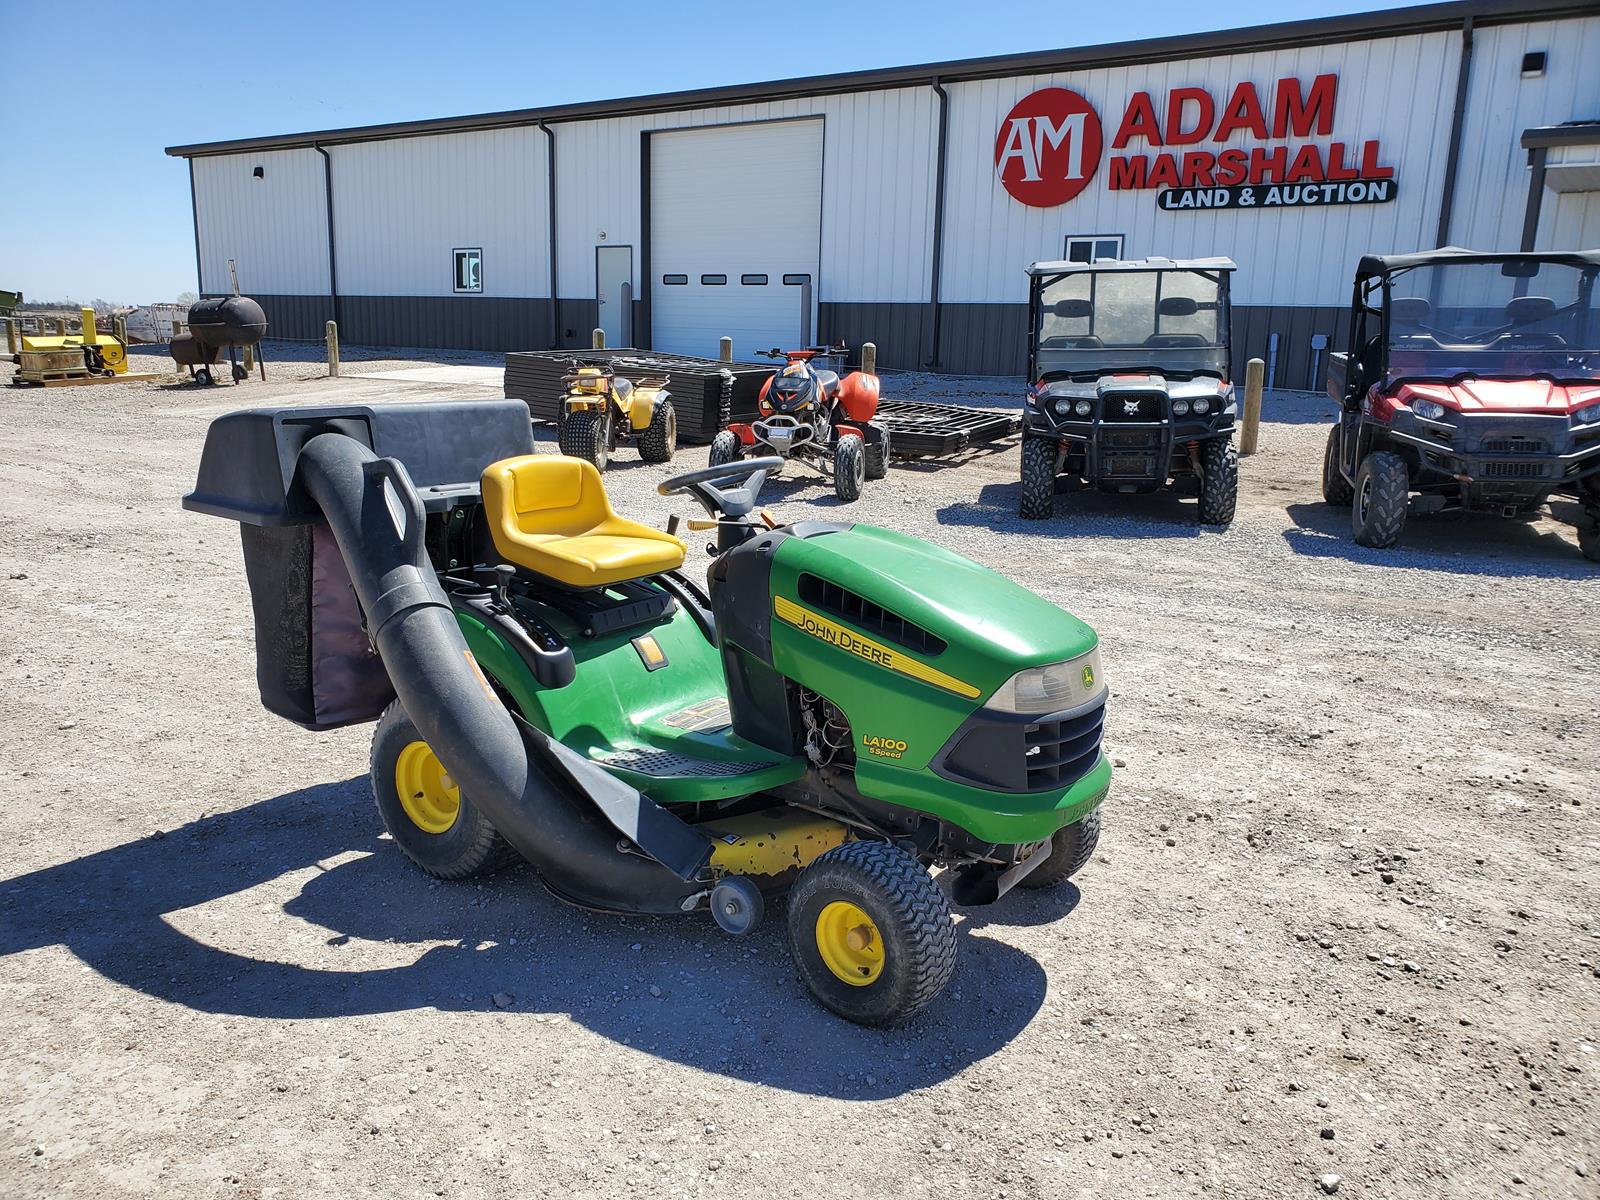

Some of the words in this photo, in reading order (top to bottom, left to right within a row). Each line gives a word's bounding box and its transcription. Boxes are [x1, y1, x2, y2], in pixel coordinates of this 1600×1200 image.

[1111, 73, 1338, 149] ADAM
[998, 112, 1089, 183] AM
[1108, 140, 1394, 190] MARSHALL
[1165, 189, 1230, 208] LAND
[1238, 188, 1257, 206] &
[1264, 181, 1388, 205] AUCTION
[797, 614, 837, 643] JOHN
[840, 631, 893, 667] DEERE
[863, 734, 907, 751] LA100
